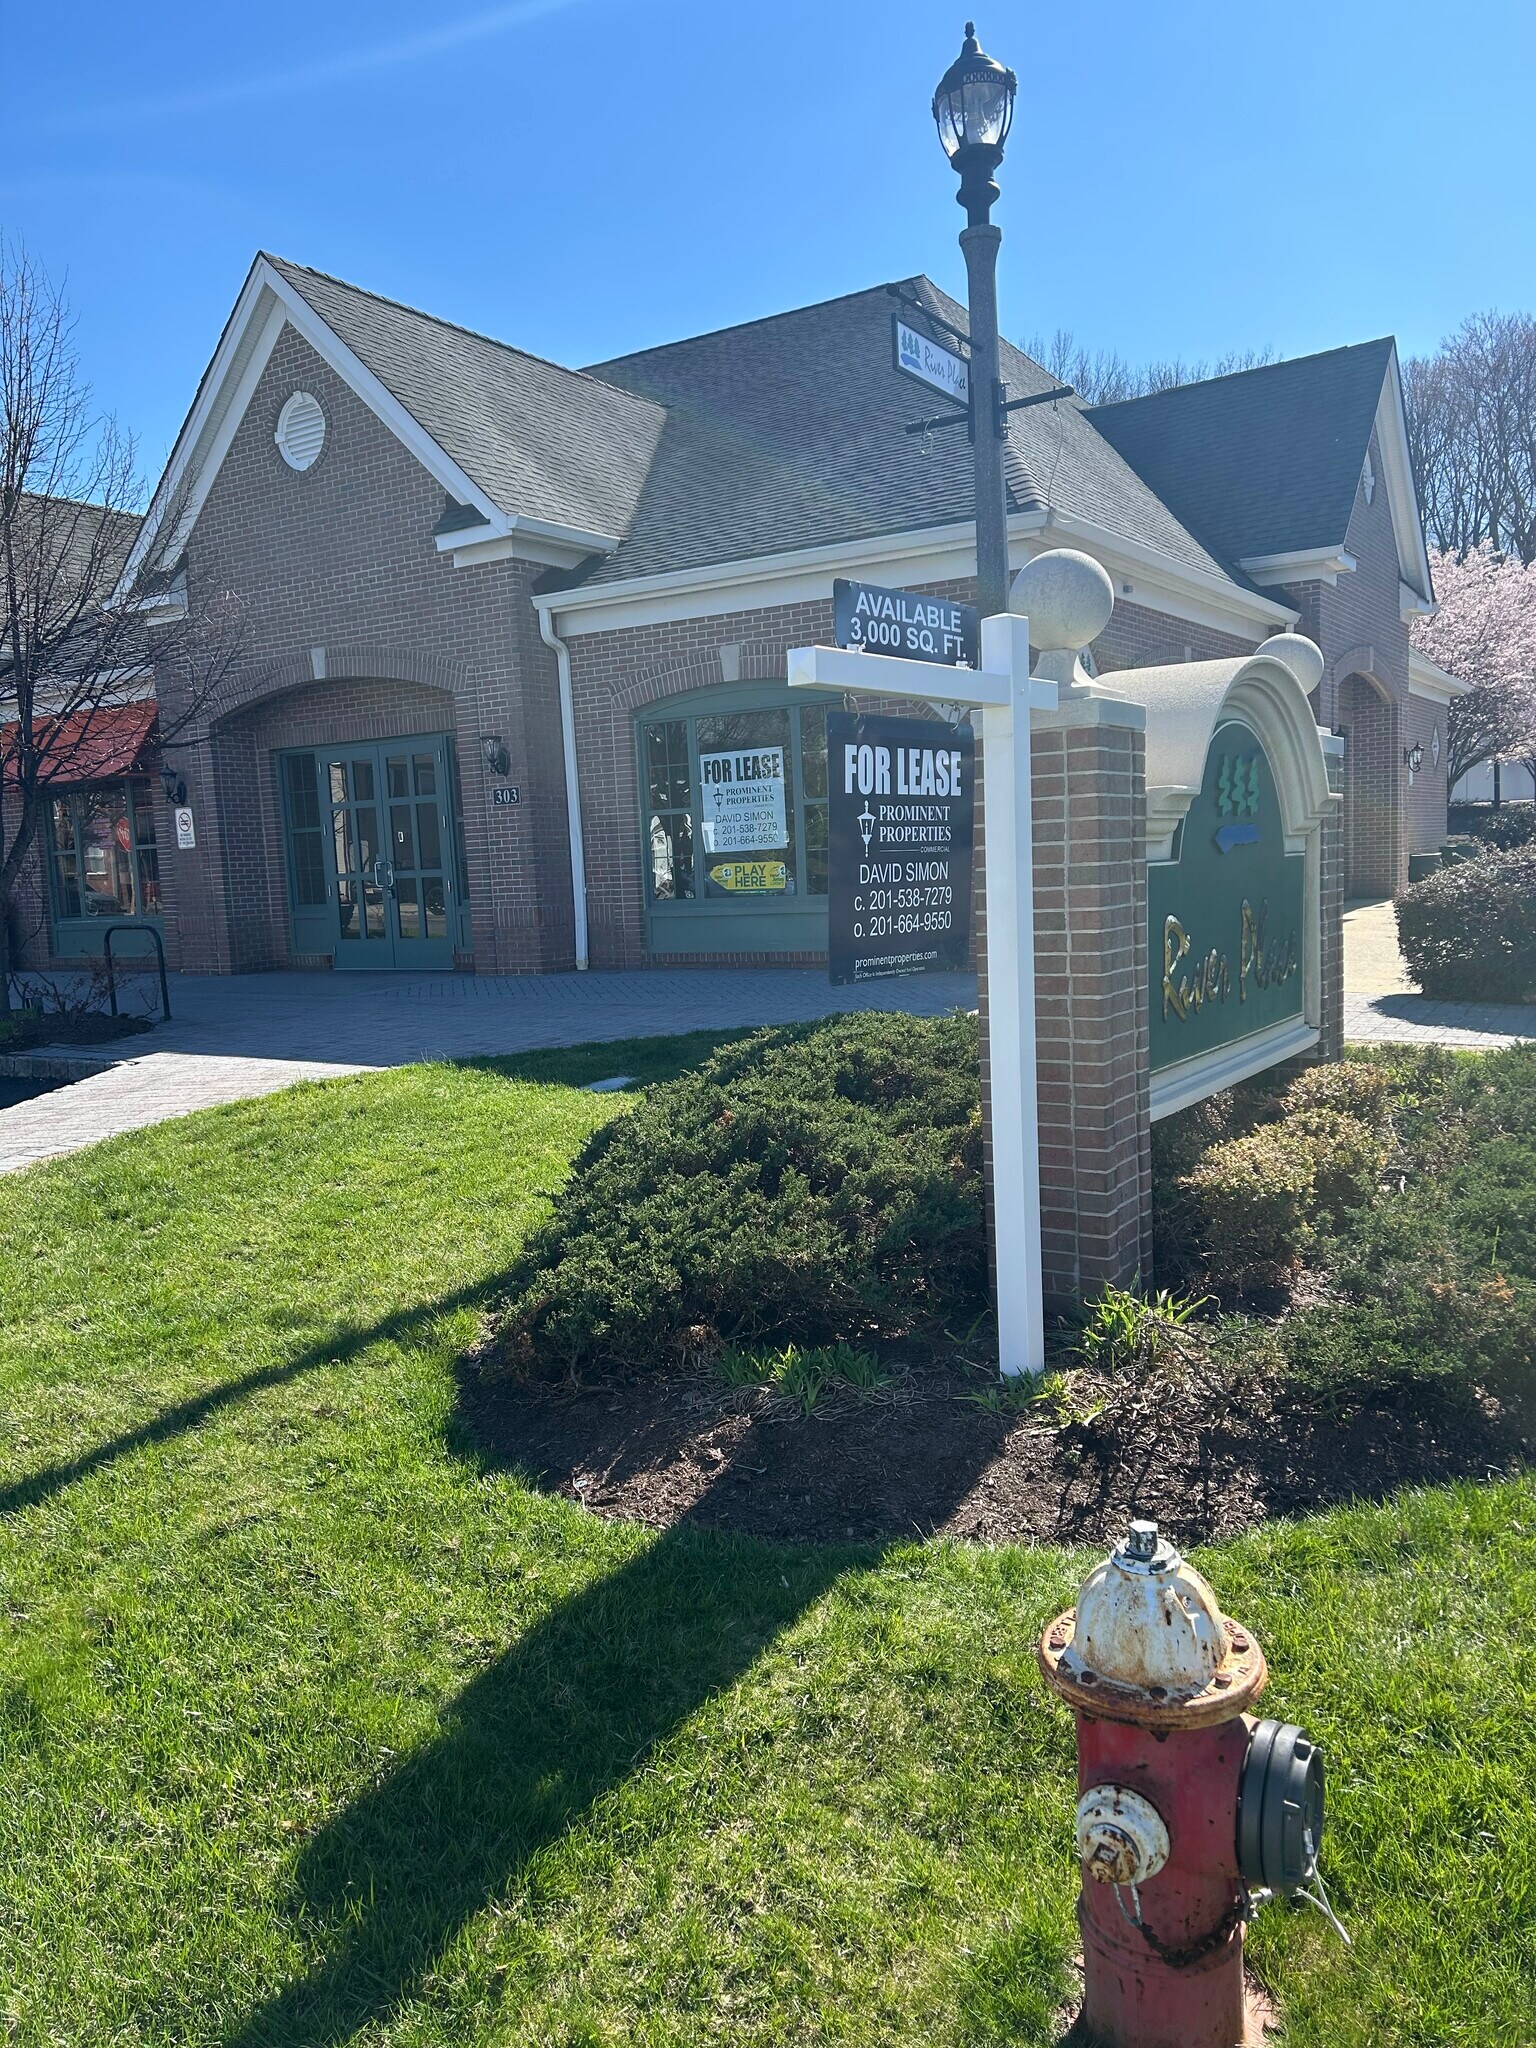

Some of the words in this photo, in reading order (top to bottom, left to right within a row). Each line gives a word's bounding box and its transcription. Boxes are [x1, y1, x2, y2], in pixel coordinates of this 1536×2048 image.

[924, 345, 946, 379] River
[855, 591, 962, 633] AVAILABLE
[850, 616, 901, 647] 3,000
[906, 627, 939, 655] SQ.
[943, 633, 967, 658] FT.
[703, 758, 733, 785] FOR
[735, 753, 781, 782] LEASE
[844, 743, 892, 796] FOR
[897, 747, 962, 797] LEASE
[495, 788, 518, 804] 303
[725, 784, 774, 796] PROMINENT
[726, 793, 775, 806] PROPERTIES
[715, 813, 742, 824] DAVID
[743, 810, 774, 822] SIMON
[879, 804, 951, 821] PROMINENT
[722, 821, 778, 835] 201-538-7279
[879, 825, 952, 843] PROPERTIES
[722, 833, 778, 846] 201-664-9550
[920, 845, 951, 854] COMMERCIAL
[734, 864, 767, 876] PLAY
[859, 862, 902, 884] DAVID
[905, 861, 949, 882] SIMON
[735, 876, 767, 887] HERE
[854, 896, 866, 911] c.
[869, 885, 953, 910] 201-538-7279
[853, 922, 866, 938] o.
[869, 910, 952, 937] 201-664-9550
[855, 950, 938, 971] prominentproperties.com
[1163, 913, 1231, 1024] River
